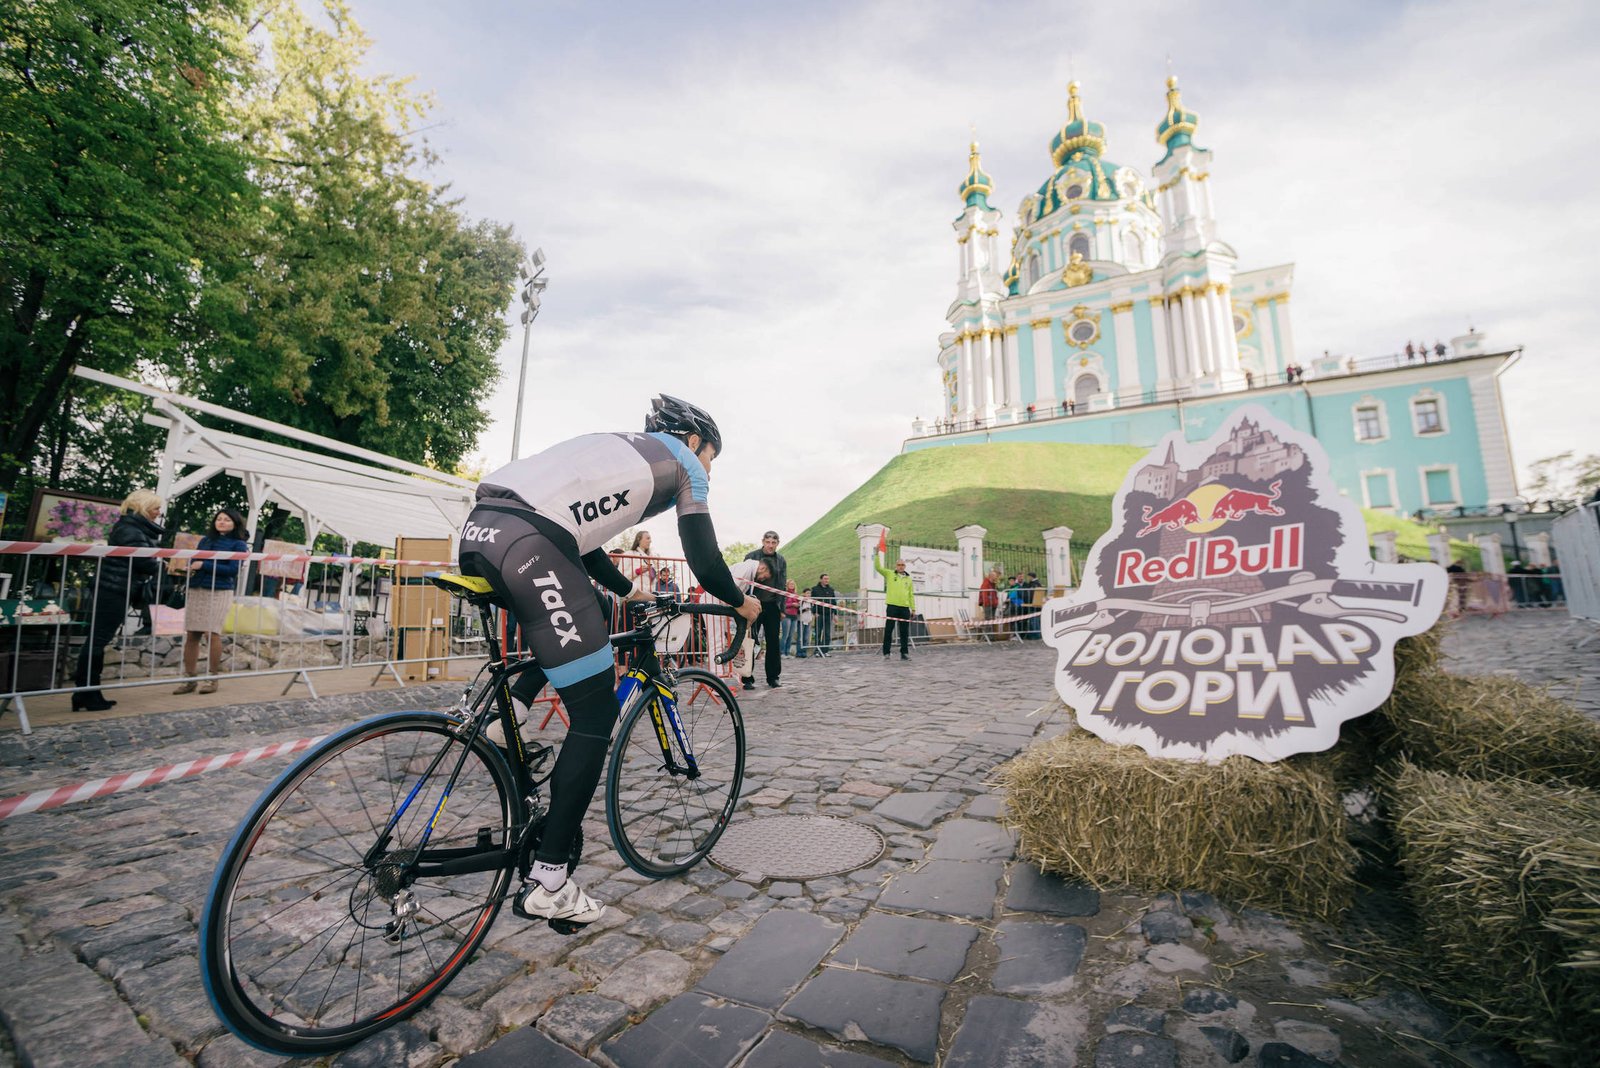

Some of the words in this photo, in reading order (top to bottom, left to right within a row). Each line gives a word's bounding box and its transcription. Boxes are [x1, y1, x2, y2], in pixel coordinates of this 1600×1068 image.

[568, 489, 630, 526] Tacx
[461, 521, 502, 544] Tacx
[517, 556, 536, 574] CRAFT
[1115, 539, 1197, 586] Red
[1204, 526, 1302, 577] Bull
[532, 570, 582, 648] Tacx
[1072, 622, 1374, 672] ВОЛОДАР
[1098, 669, 1306, 722] ГОРИ
[540, 864, 565, 872] Tacx
